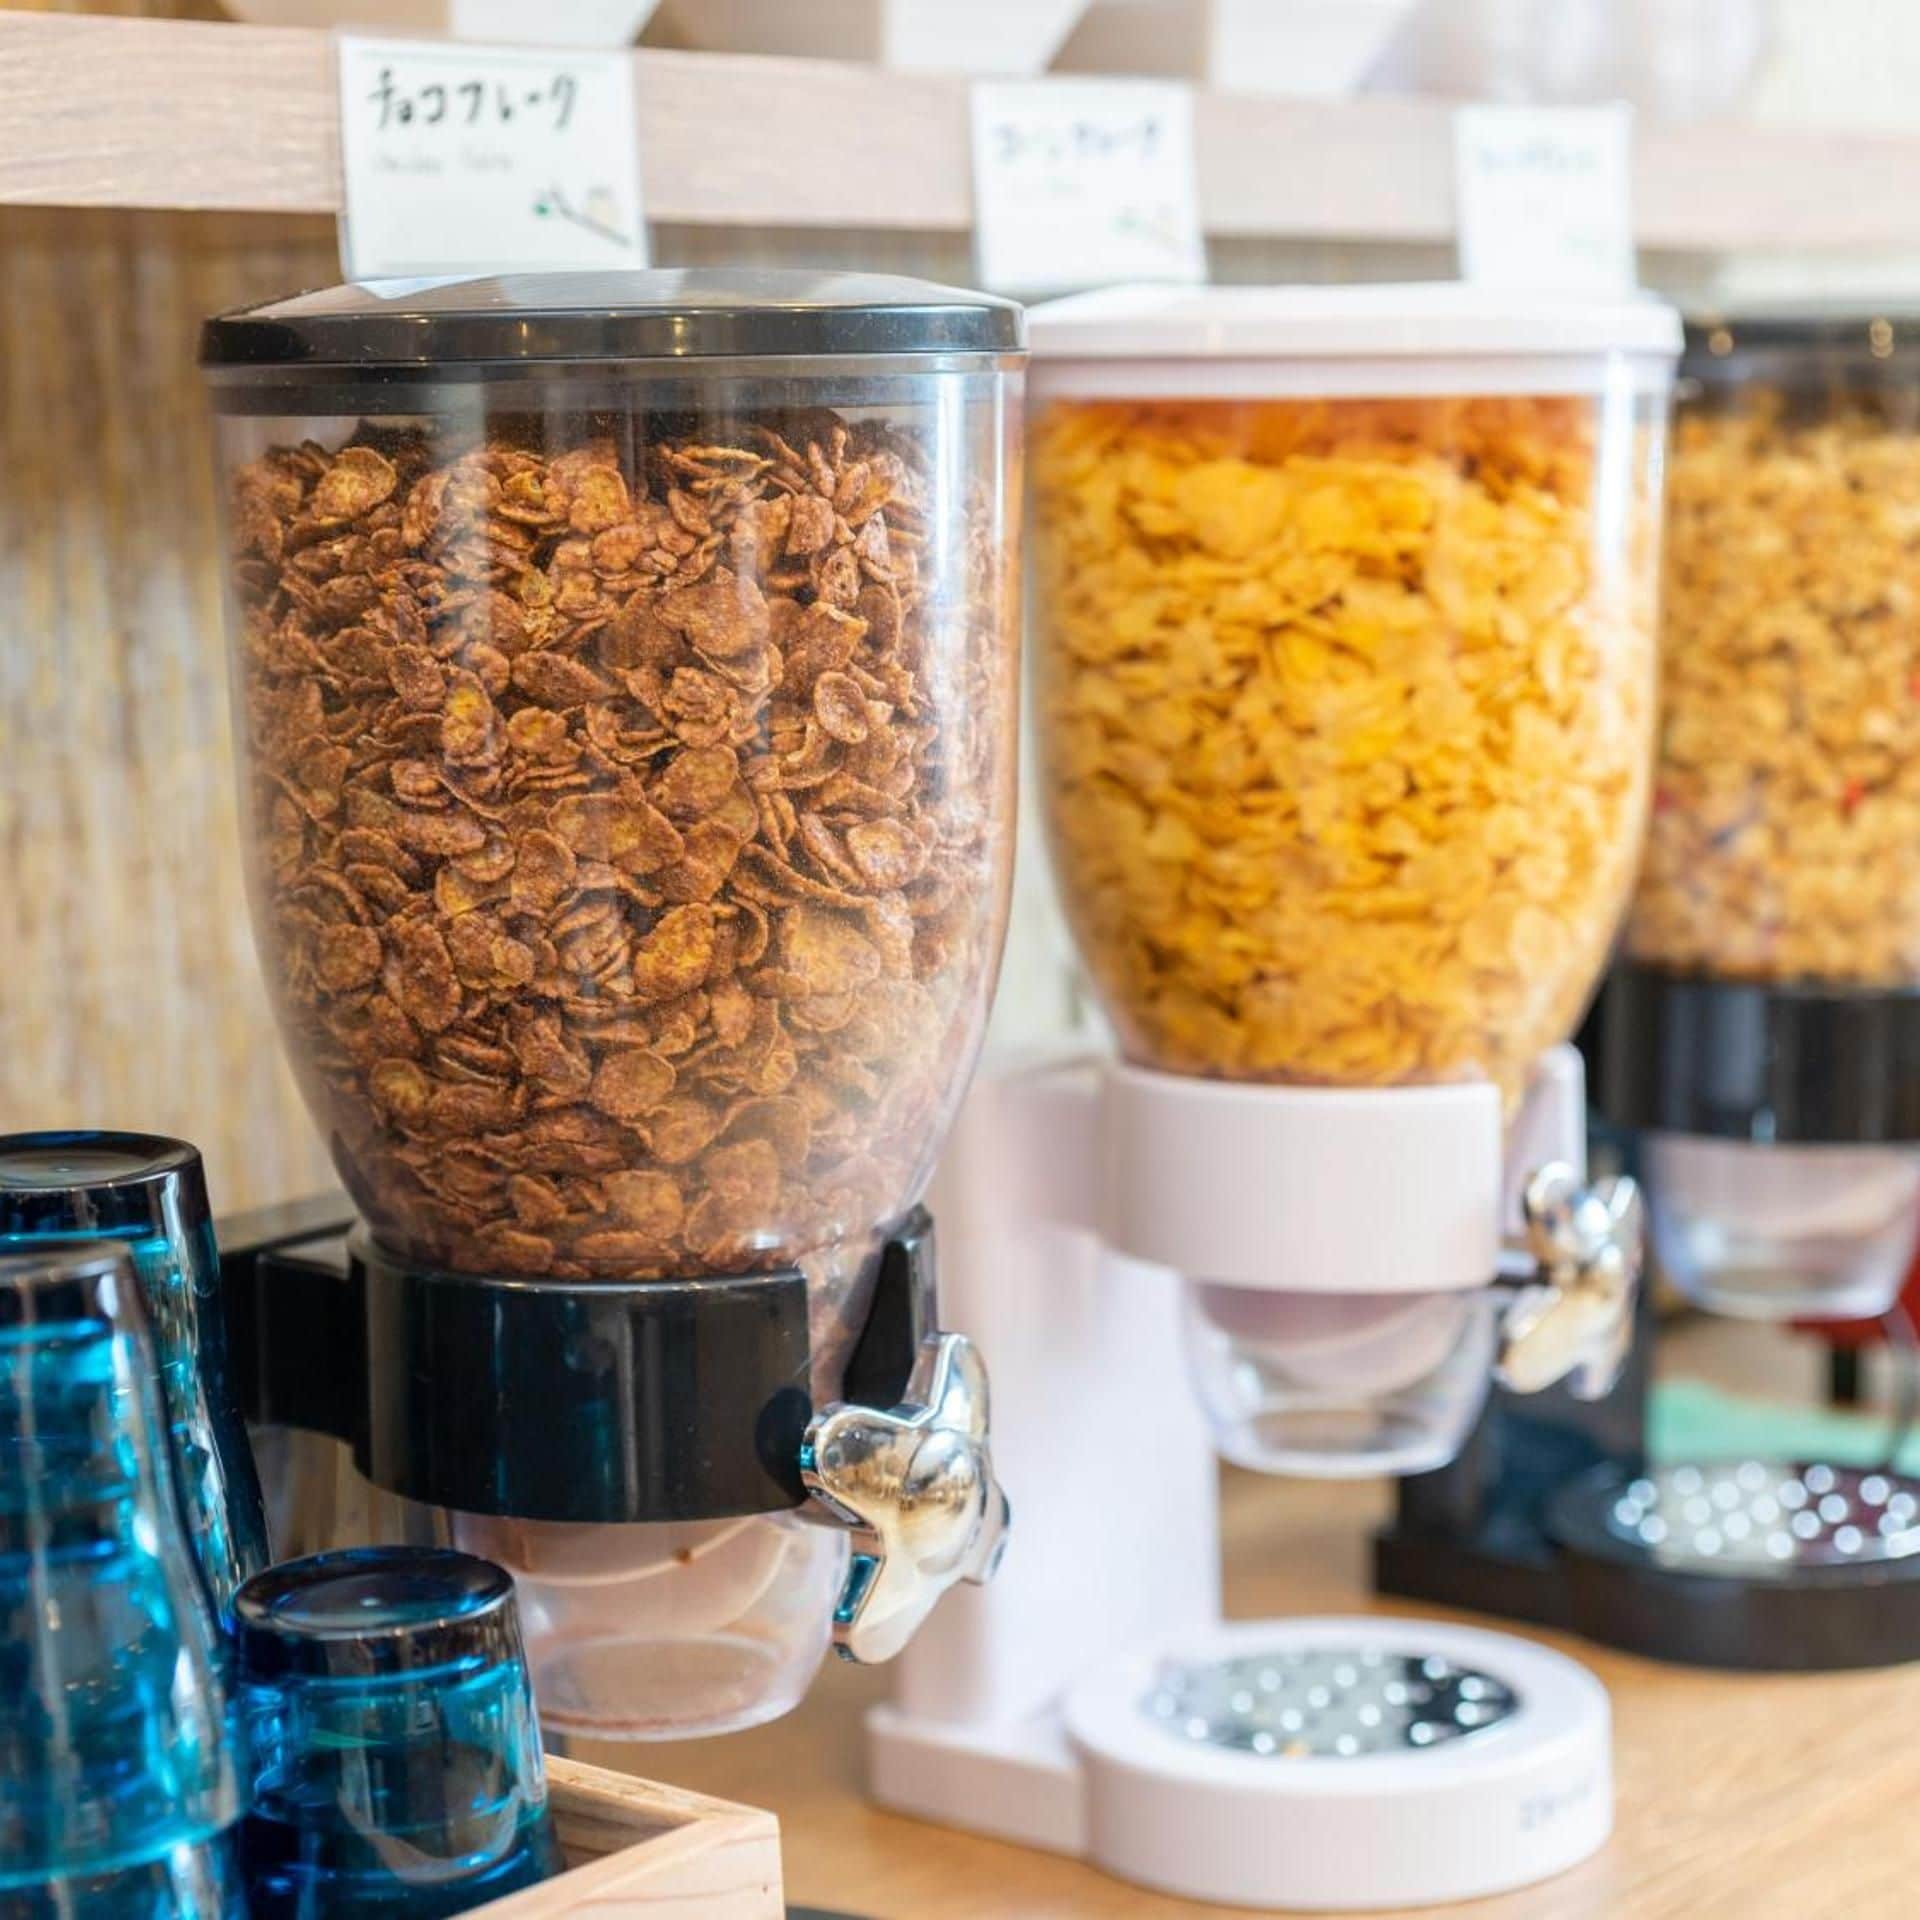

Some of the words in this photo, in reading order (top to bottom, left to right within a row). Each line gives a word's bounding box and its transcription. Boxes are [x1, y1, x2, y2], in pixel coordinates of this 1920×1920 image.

[367, 68, 578, 130] チョコフレーク
